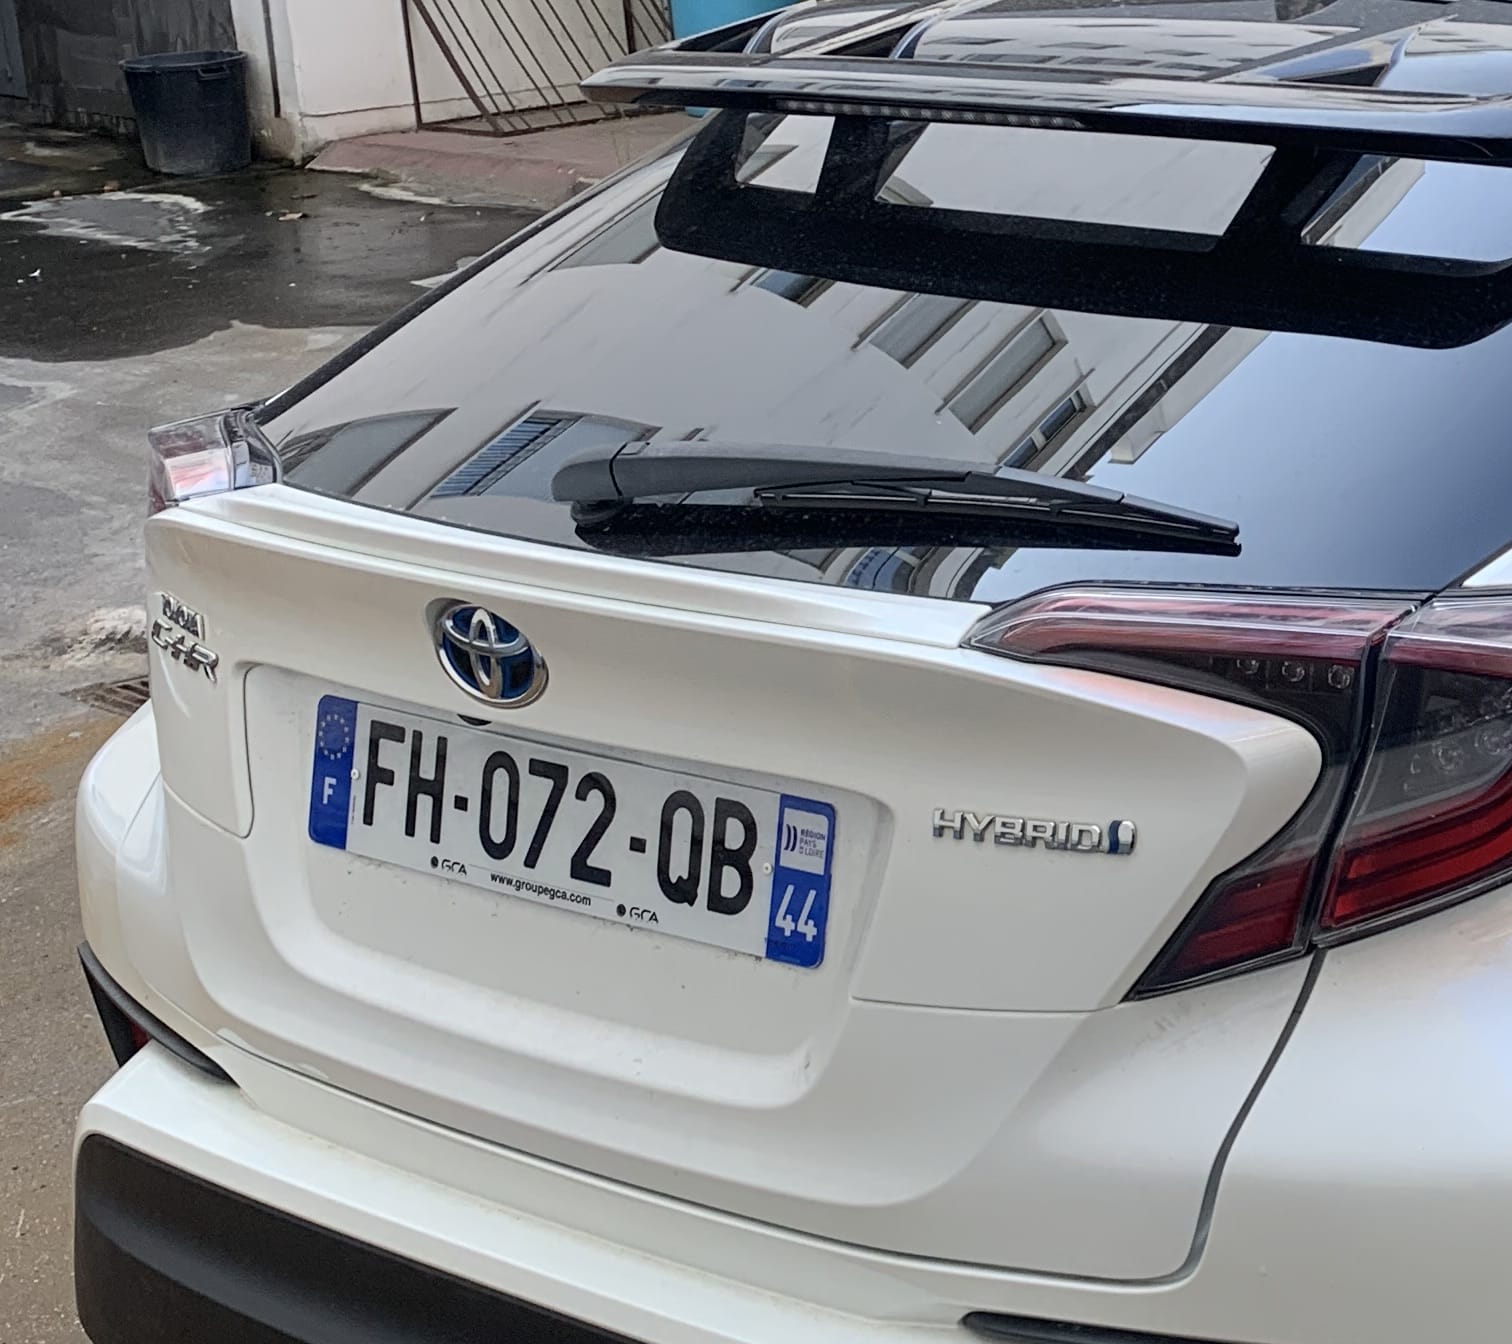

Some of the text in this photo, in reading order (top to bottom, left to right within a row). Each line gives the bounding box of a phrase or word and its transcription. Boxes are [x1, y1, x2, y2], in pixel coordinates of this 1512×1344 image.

[322, 776, 337, 805] F
[362, 719, 759, 916] FH-072-QB
[932, 808, 1102, 852] HYBRID
[441, 858, 468, 877] GCA
[489, 872, 592, 907] www.groupegca.com
[629, 906, 659, 924] GCA
[774, 884, 818, 942] 44
